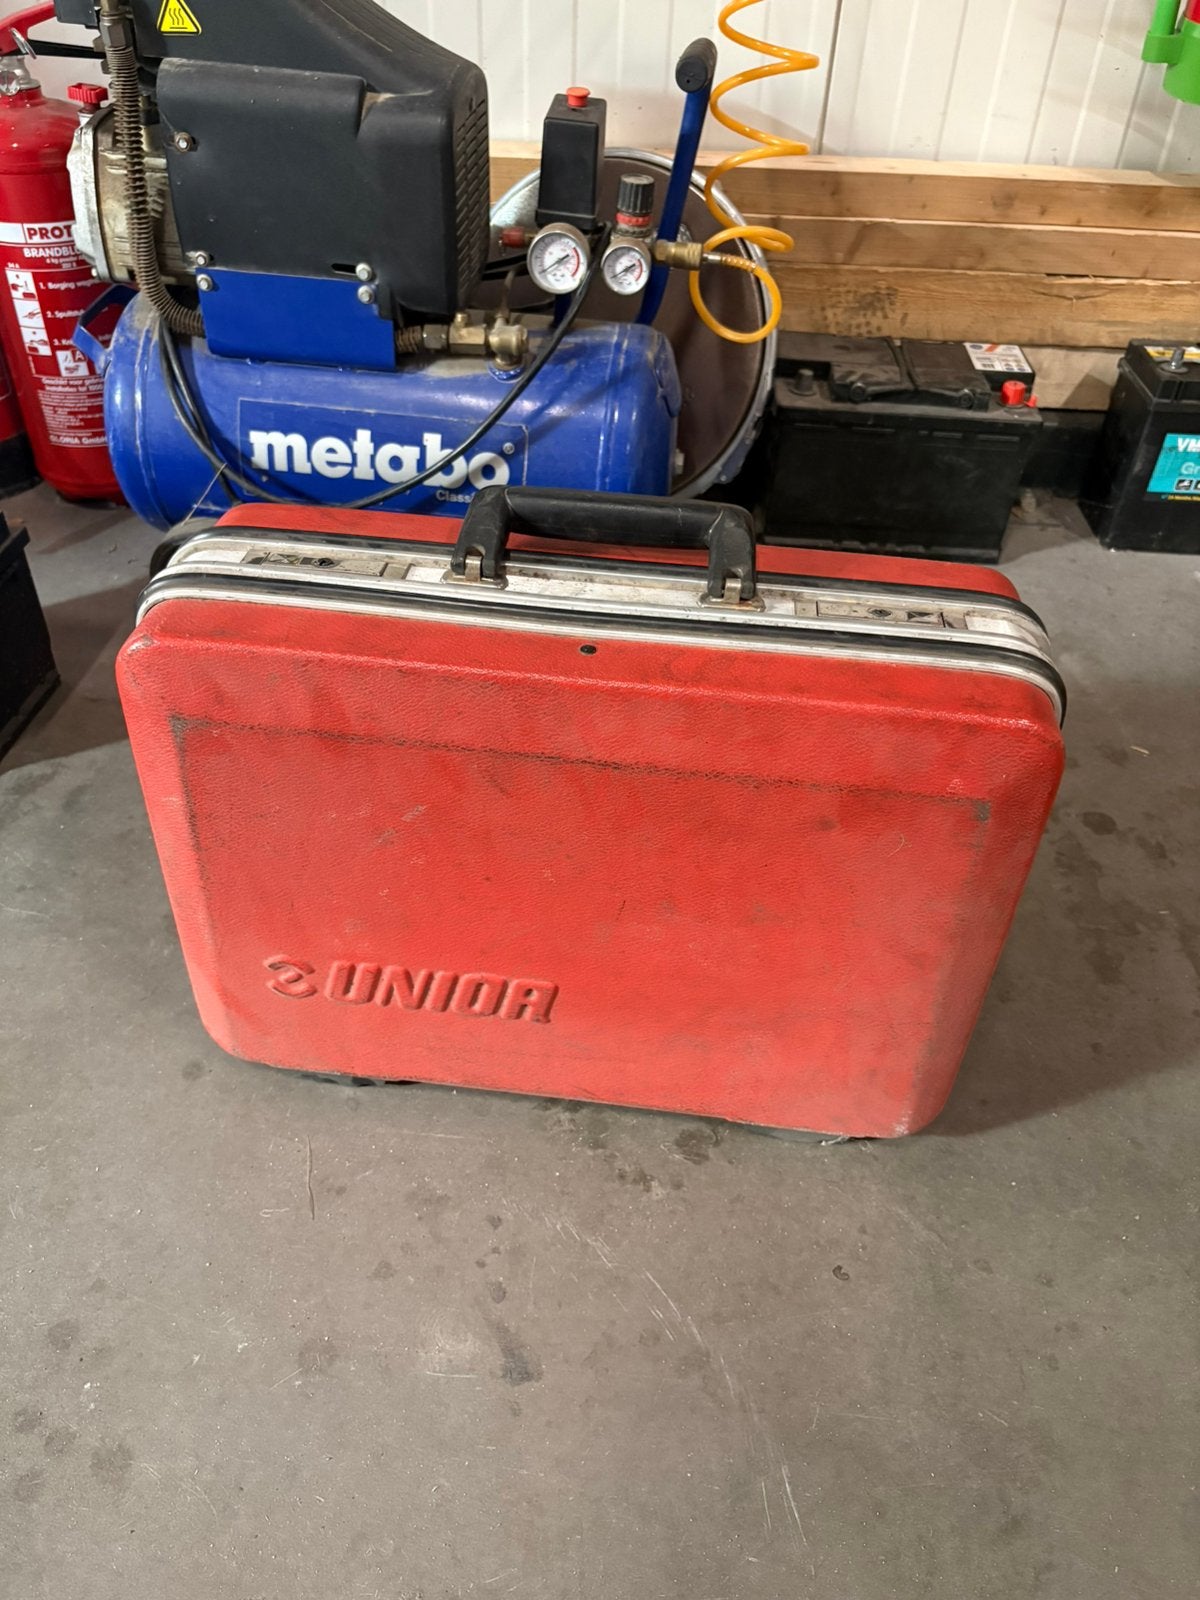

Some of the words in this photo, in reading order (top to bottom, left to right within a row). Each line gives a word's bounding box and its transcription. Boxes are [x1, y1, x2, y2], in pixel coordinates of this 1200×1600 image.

[53, 338, 60, 346] 3.
[49, 434, 80, 444] GLORIA
[249, 429, 511, 490] metabo
[435, 489, 476, 504] Class
[324, 959, 559, 1024] UNIOR
